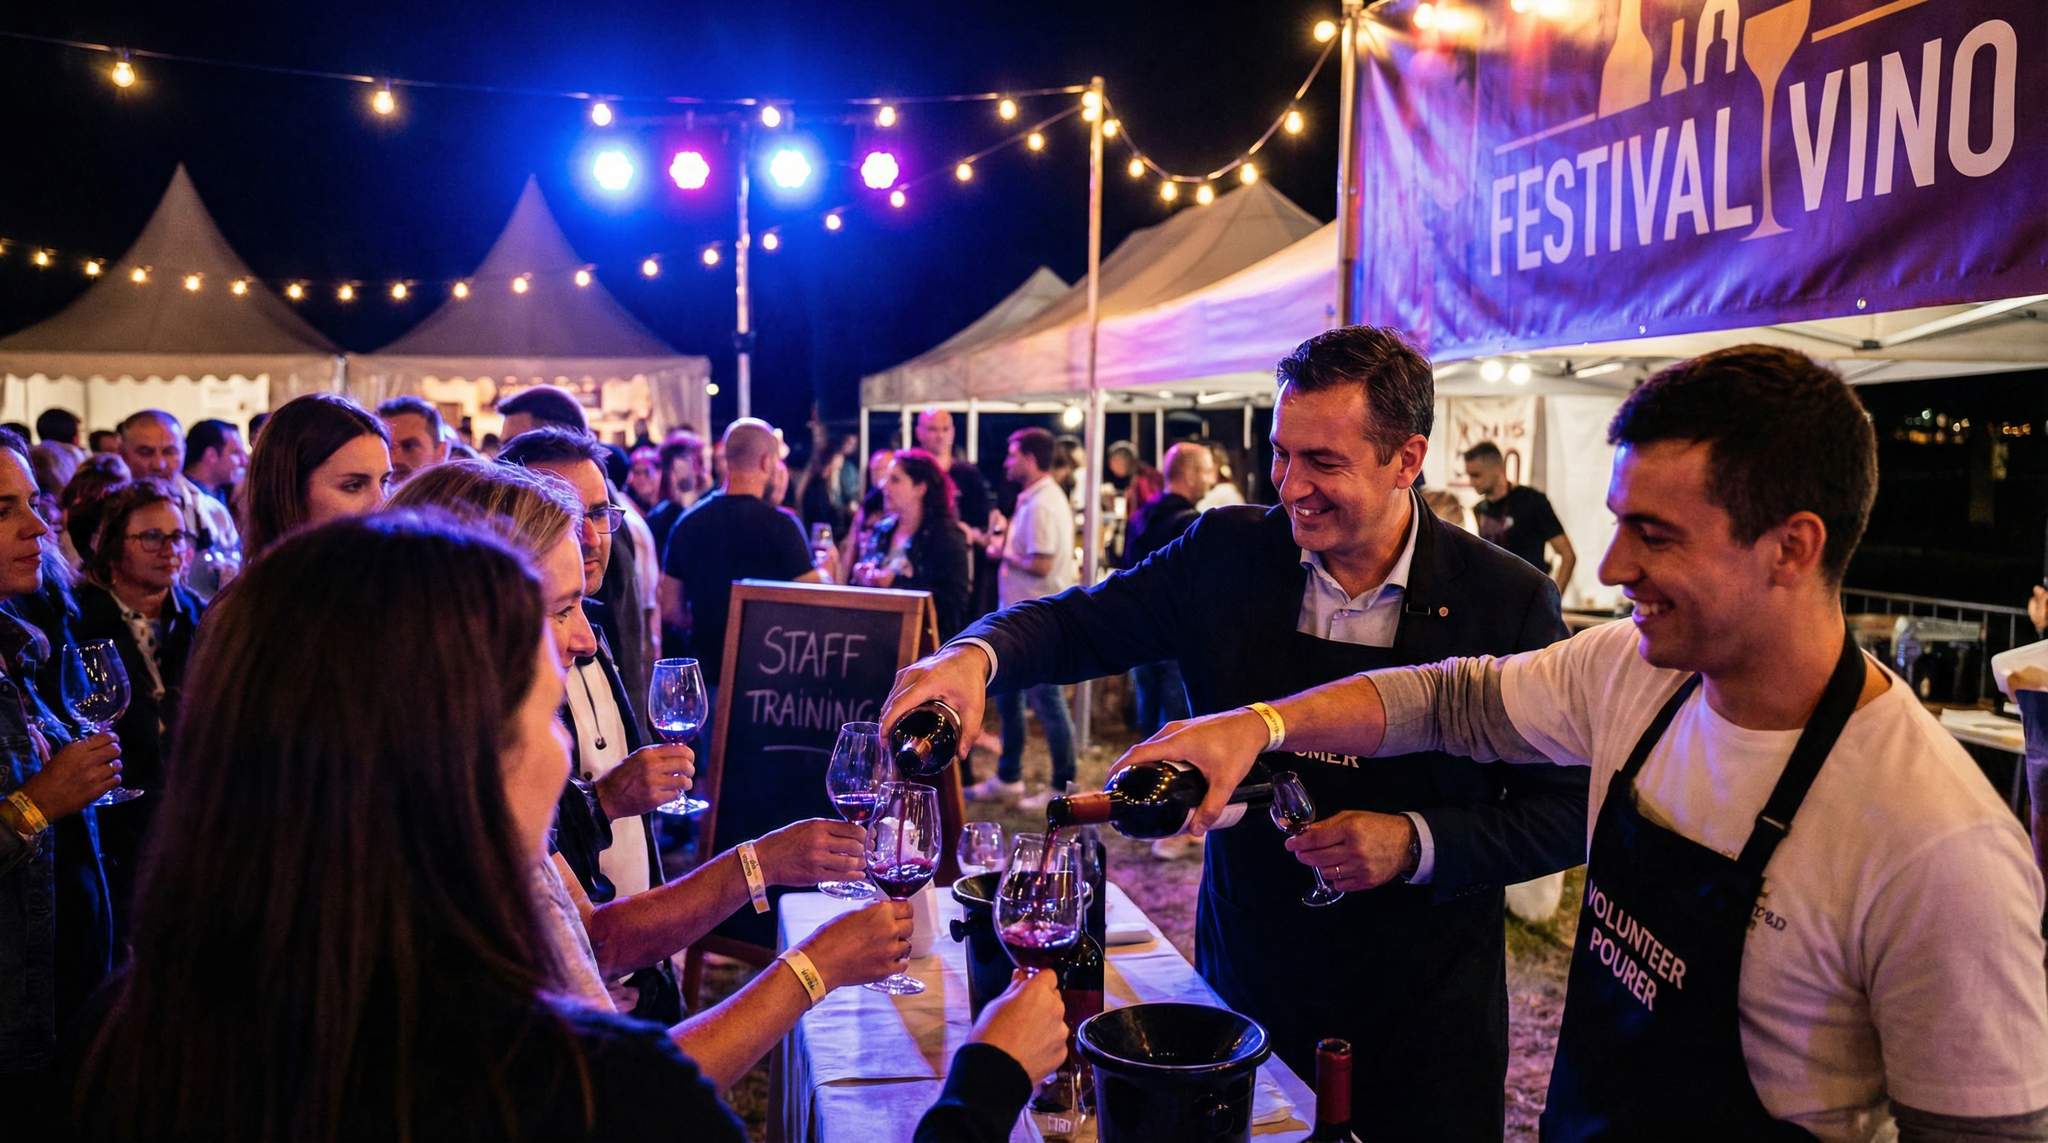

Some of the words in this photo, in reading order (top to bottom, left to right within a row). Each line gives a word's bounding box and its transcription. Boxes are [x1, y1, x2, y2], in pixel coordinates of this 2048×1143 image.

[1490, 106, 1753, 277] FESTIVAL
[1789, 19, 2018, 212] VINO
[759, 626, 867, 678] STAFF
[1588, 878, 1687, 989] VOLUNTEER
[1590, 927, 1657, 1011] POURER
